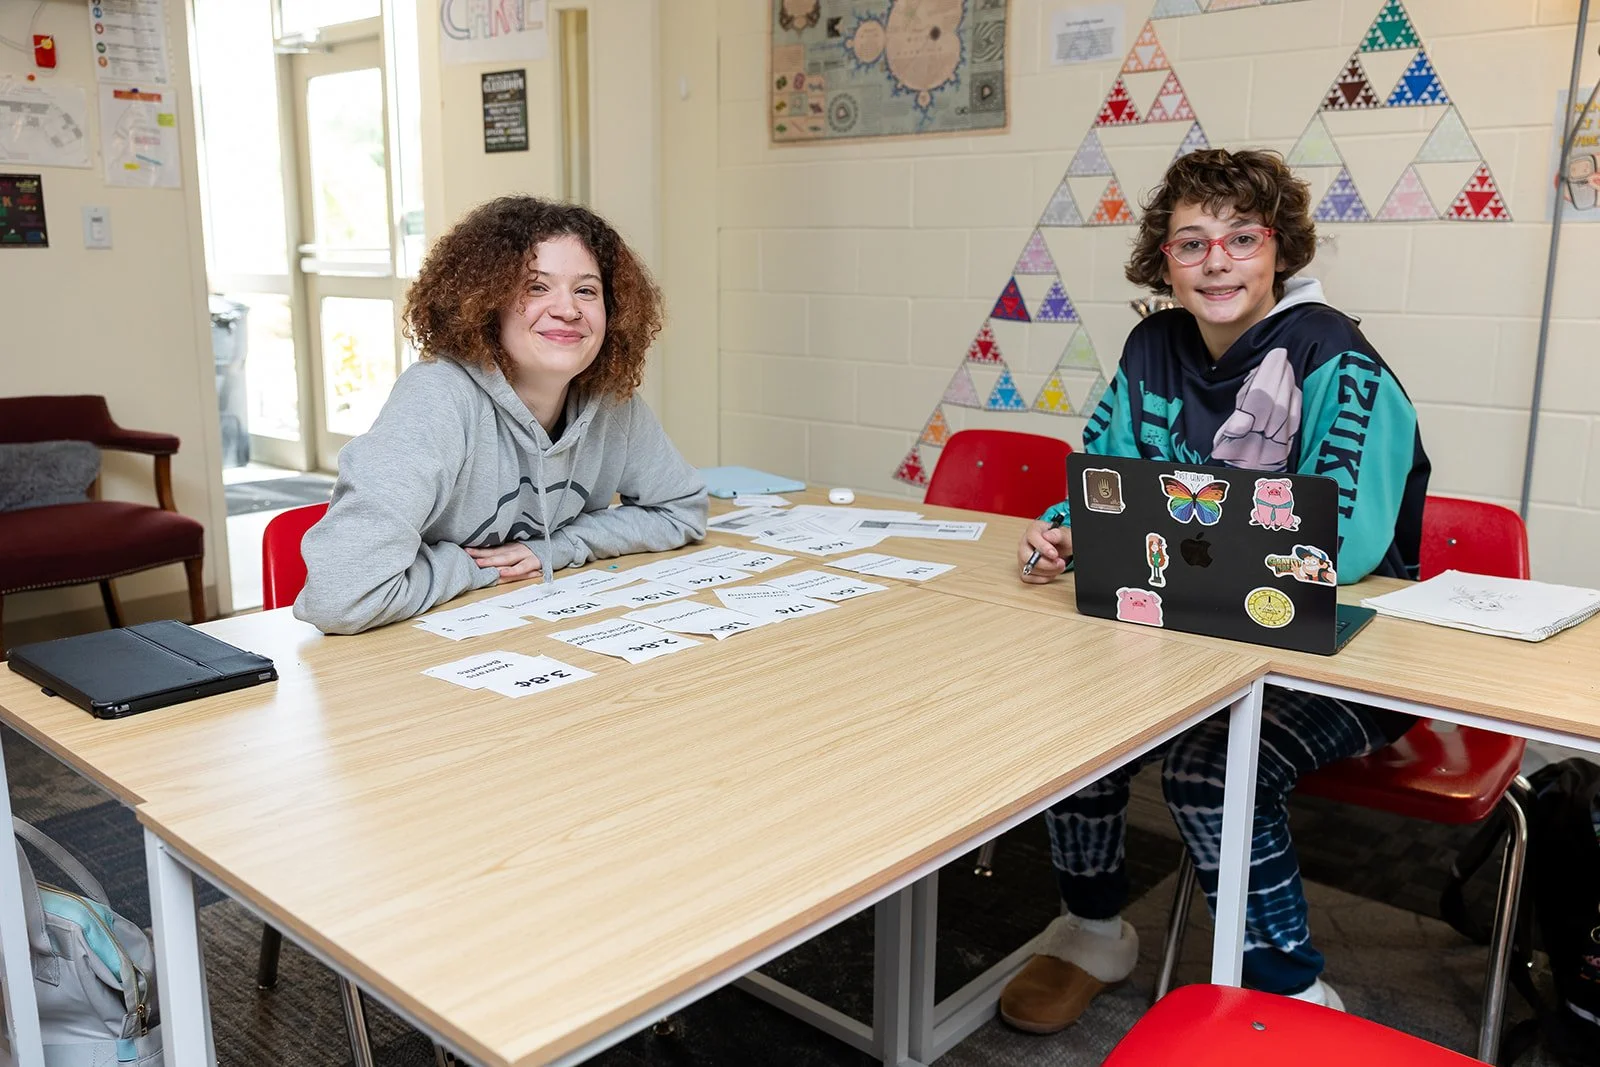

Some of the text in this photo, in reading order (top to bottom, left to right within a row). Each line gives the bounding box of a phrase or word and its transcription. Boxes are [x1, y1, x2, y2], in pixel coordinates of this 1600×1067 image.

[547, 602, 601, 616] 15.9¢
[627, 637, 678, 653] 2.8¢
[457, 659, 502, 676] Benefits
[465, 662, 515, 680] Veterans
[513, 669, 573, 689] 3.8¢
